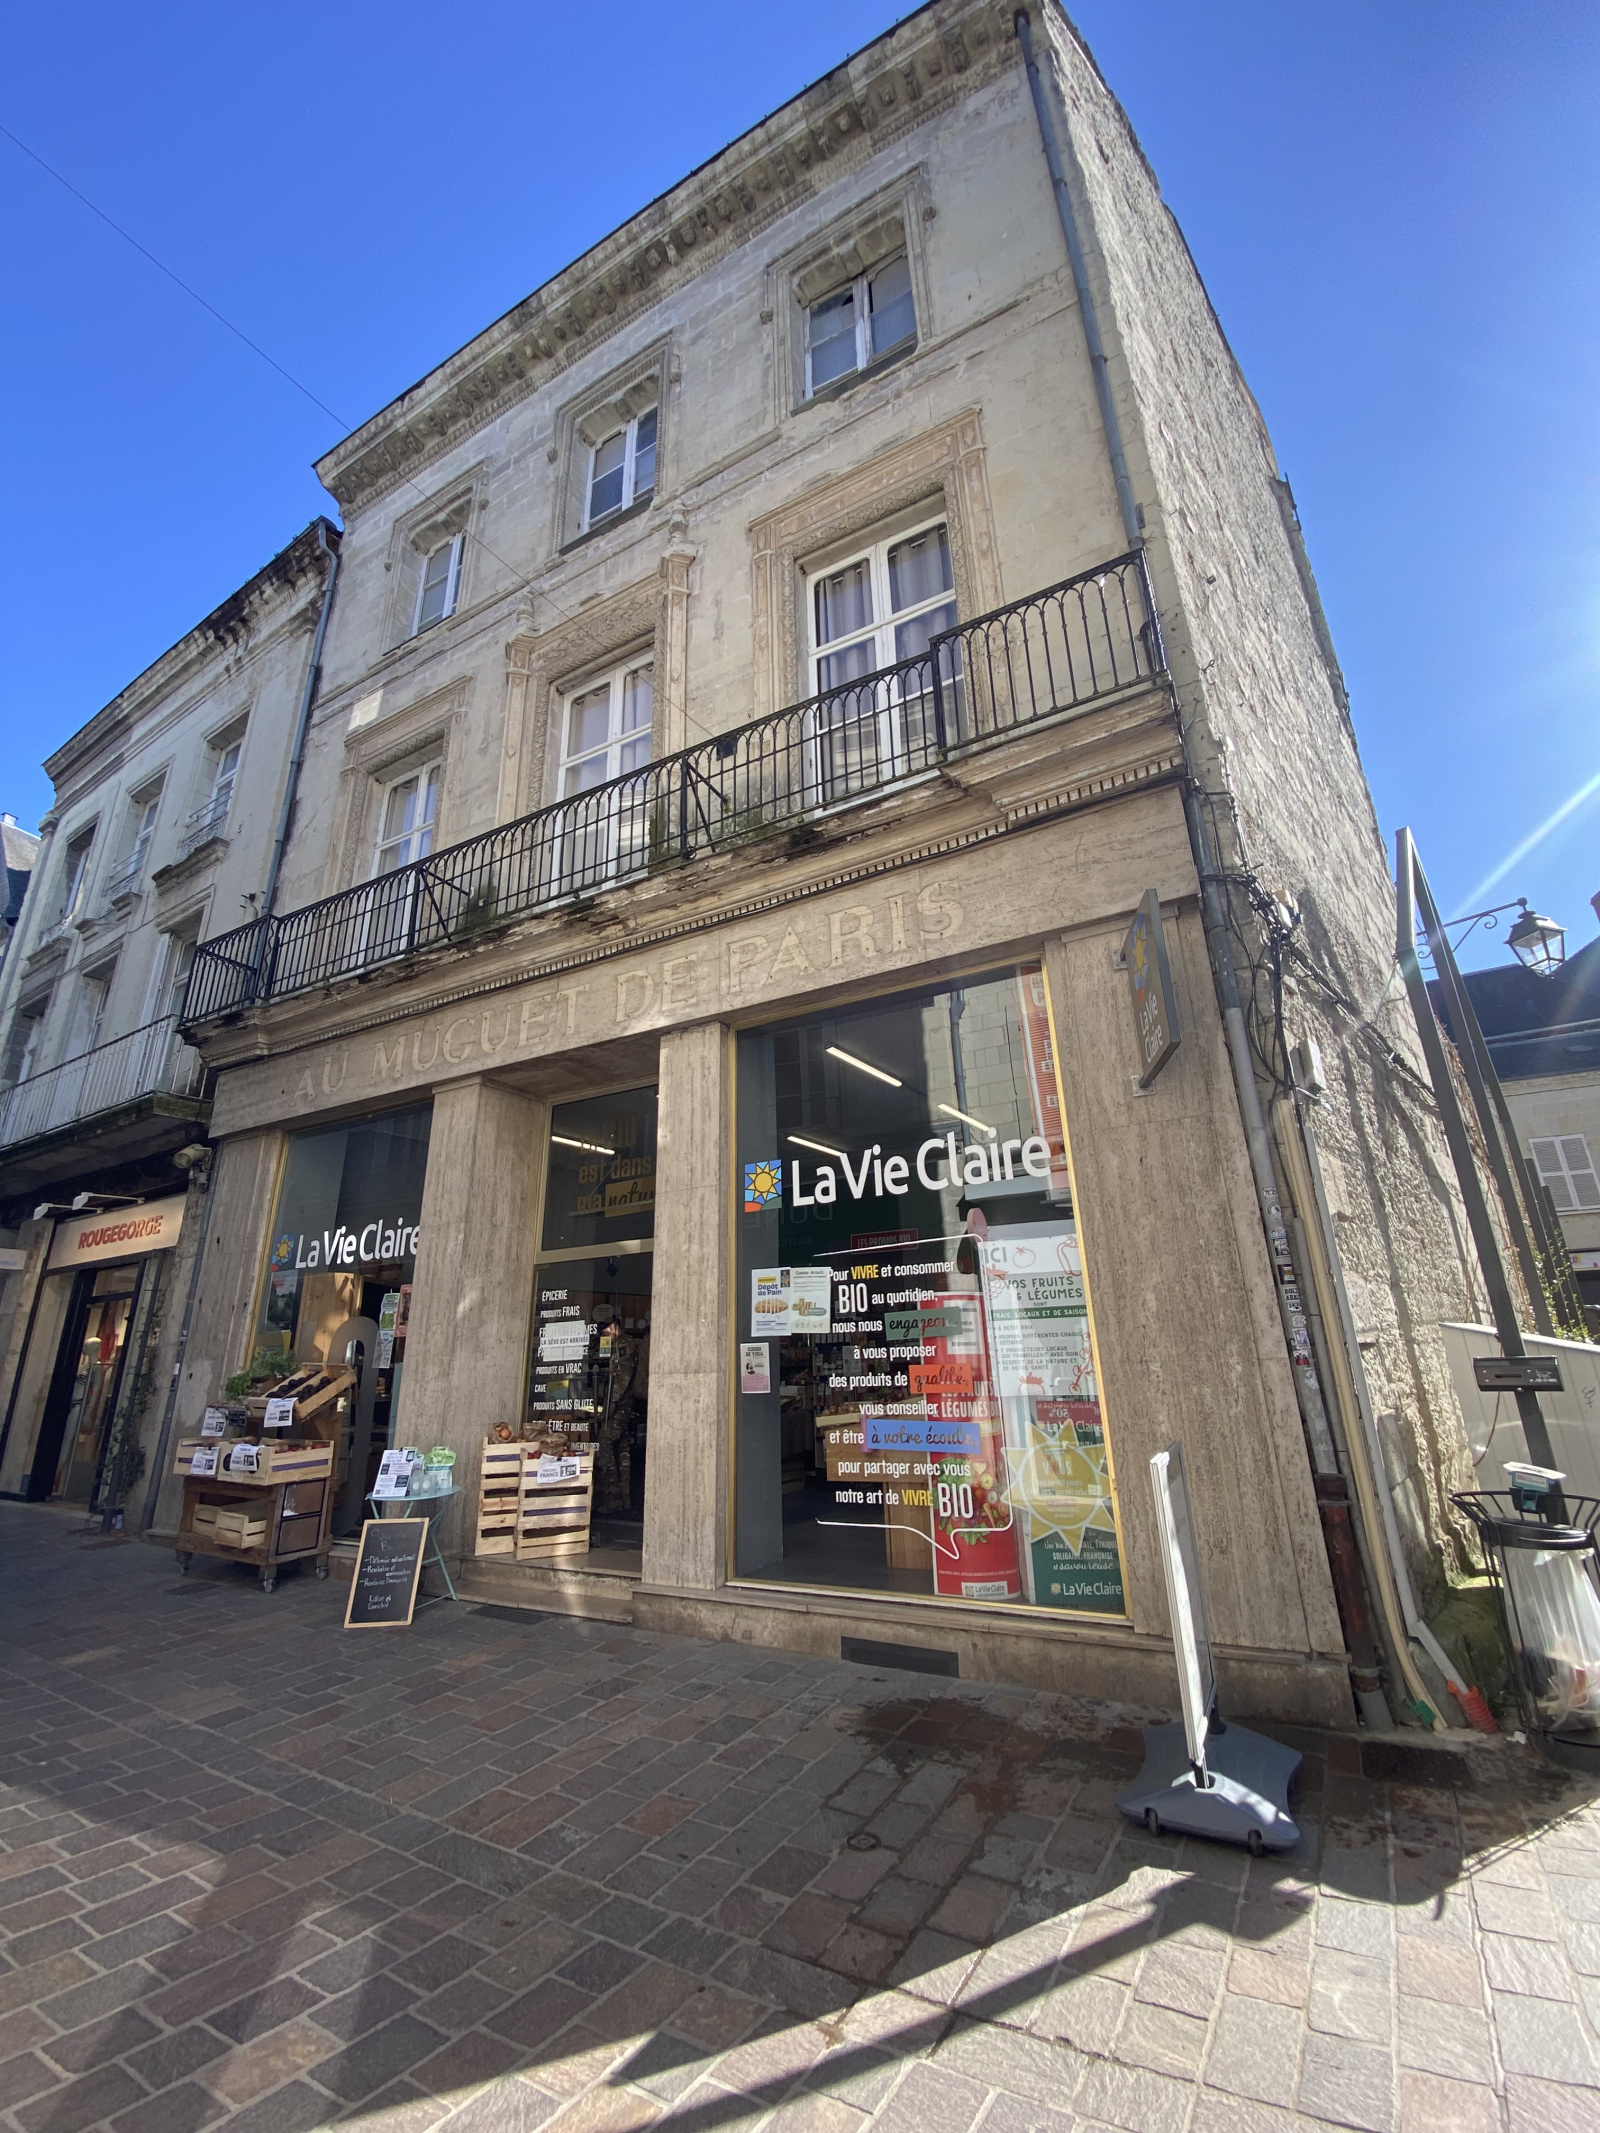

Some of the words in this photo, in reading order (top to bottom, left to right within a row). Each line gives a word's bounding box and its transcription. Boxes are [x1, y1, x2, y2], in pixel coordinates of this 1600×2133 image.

[292, 1051, 349, 1106] AU
[371, 983, 590, 1084] MUGUET
[614, 953, 699, 1023] DE
[726, 878, 965, 995] PARIS
[1146, 992, 1158, 1022] Vie
[1145, 1023, 1163, 1063] Claire
[579, 1159, 606, 1184] est
[610, 1153, 652, 1179] dans
[792, 1159, 836, 1207] La
[840, 1144, 909, 1199] Vie
[916, 1127, 1052, 1188] Claire
[78, 1215, 163, 1250] ROUGEGORGE
[295, 1234, 320, 1268] La
[323, 1225, 357, 1265] Vie
[360, 1217, 420, 1262] Claire
[858, 1238, 867, 1248] LES
[869, 1235, 898, 1247] PROMOS
[828, 1269, 849, 1281] Pour
[851, 1265, 879, 1280] VIVRE
[881, 1266, 892, 1277] et
[893, 1261, 955, 1276] consommer
[1005, 1279, 1027, 1289] VOS
[1032, 1276, 1074, 1288] FRUITS
[542, 1289, 568, 1302] ÉPICERIE
[838, 1283, 867, 1313] BIO
[871, 1294, 884, 1304] au
[887, 1288, 938, 1306] quotidien,
[1027, 1287, 1083, 1301] LÉGUMES
[541, 1309, 561, 1318] PRODUITS
[562, 1305, 580, 1316] FRAIS
[832, 1323, 855, 1333] nous
[858, 1320, 882, 1332] nous
[854, 1345, 861, 1358] à
[862, 1347, 887, 1358] vous
[889, 1345, 936, 1360] proposer
[558, 1366, 564, 1374] EN
[566, 1362, 582, 1374] VRAC
[829, 1373, 847, 1388] des
[849, 1372, 893, 1390] produits
[895, 1371, 908, 1386] de
[534, 1384, 547, 1393] CAVE
[533, 1401, 555, 1410] PRODUITS
[556, 1399, 572, 1410] SANS
[859, 1403, 884, 1415] vous
[886, 1400, 938, 1415] conseiller
[941, 1398, 988, 1418] LÉGUMES
[564, 1423, 570, 1431] ET
[570, 1422, 589, 1431] BEAUTÉ
[1047, 1421, 1058, 1432] La
[829, 1431, 841, 1444] et
[843, 1429, 864, 1444] être
[872, 1426, 880, 1443] à
[884, 1425, 922, 1444] votre
[838, 1461, 861, 1477] pour
[864, 1461, 910, 1478] partager
[913, 1463, 940, 1476] avec
[943, 1464, 971, 1476] vous
[836, 1489, 863, 1503] notre
[866, 1490, 882, 1504] art
[886, 1489, 899, 1505] de
[901, 1489, 933, 1507] VIVRE
[938, 1483, 974, 1518] BIO
[982, 1585, 990, 1593] Vie
[991, 1584, 1005, 1593] Claire
[1063, 1583, 1077, 1595] La
[1077, 1582, 1093, 1595] Vie
[1093, 1582, 1122, 1595] Claire
